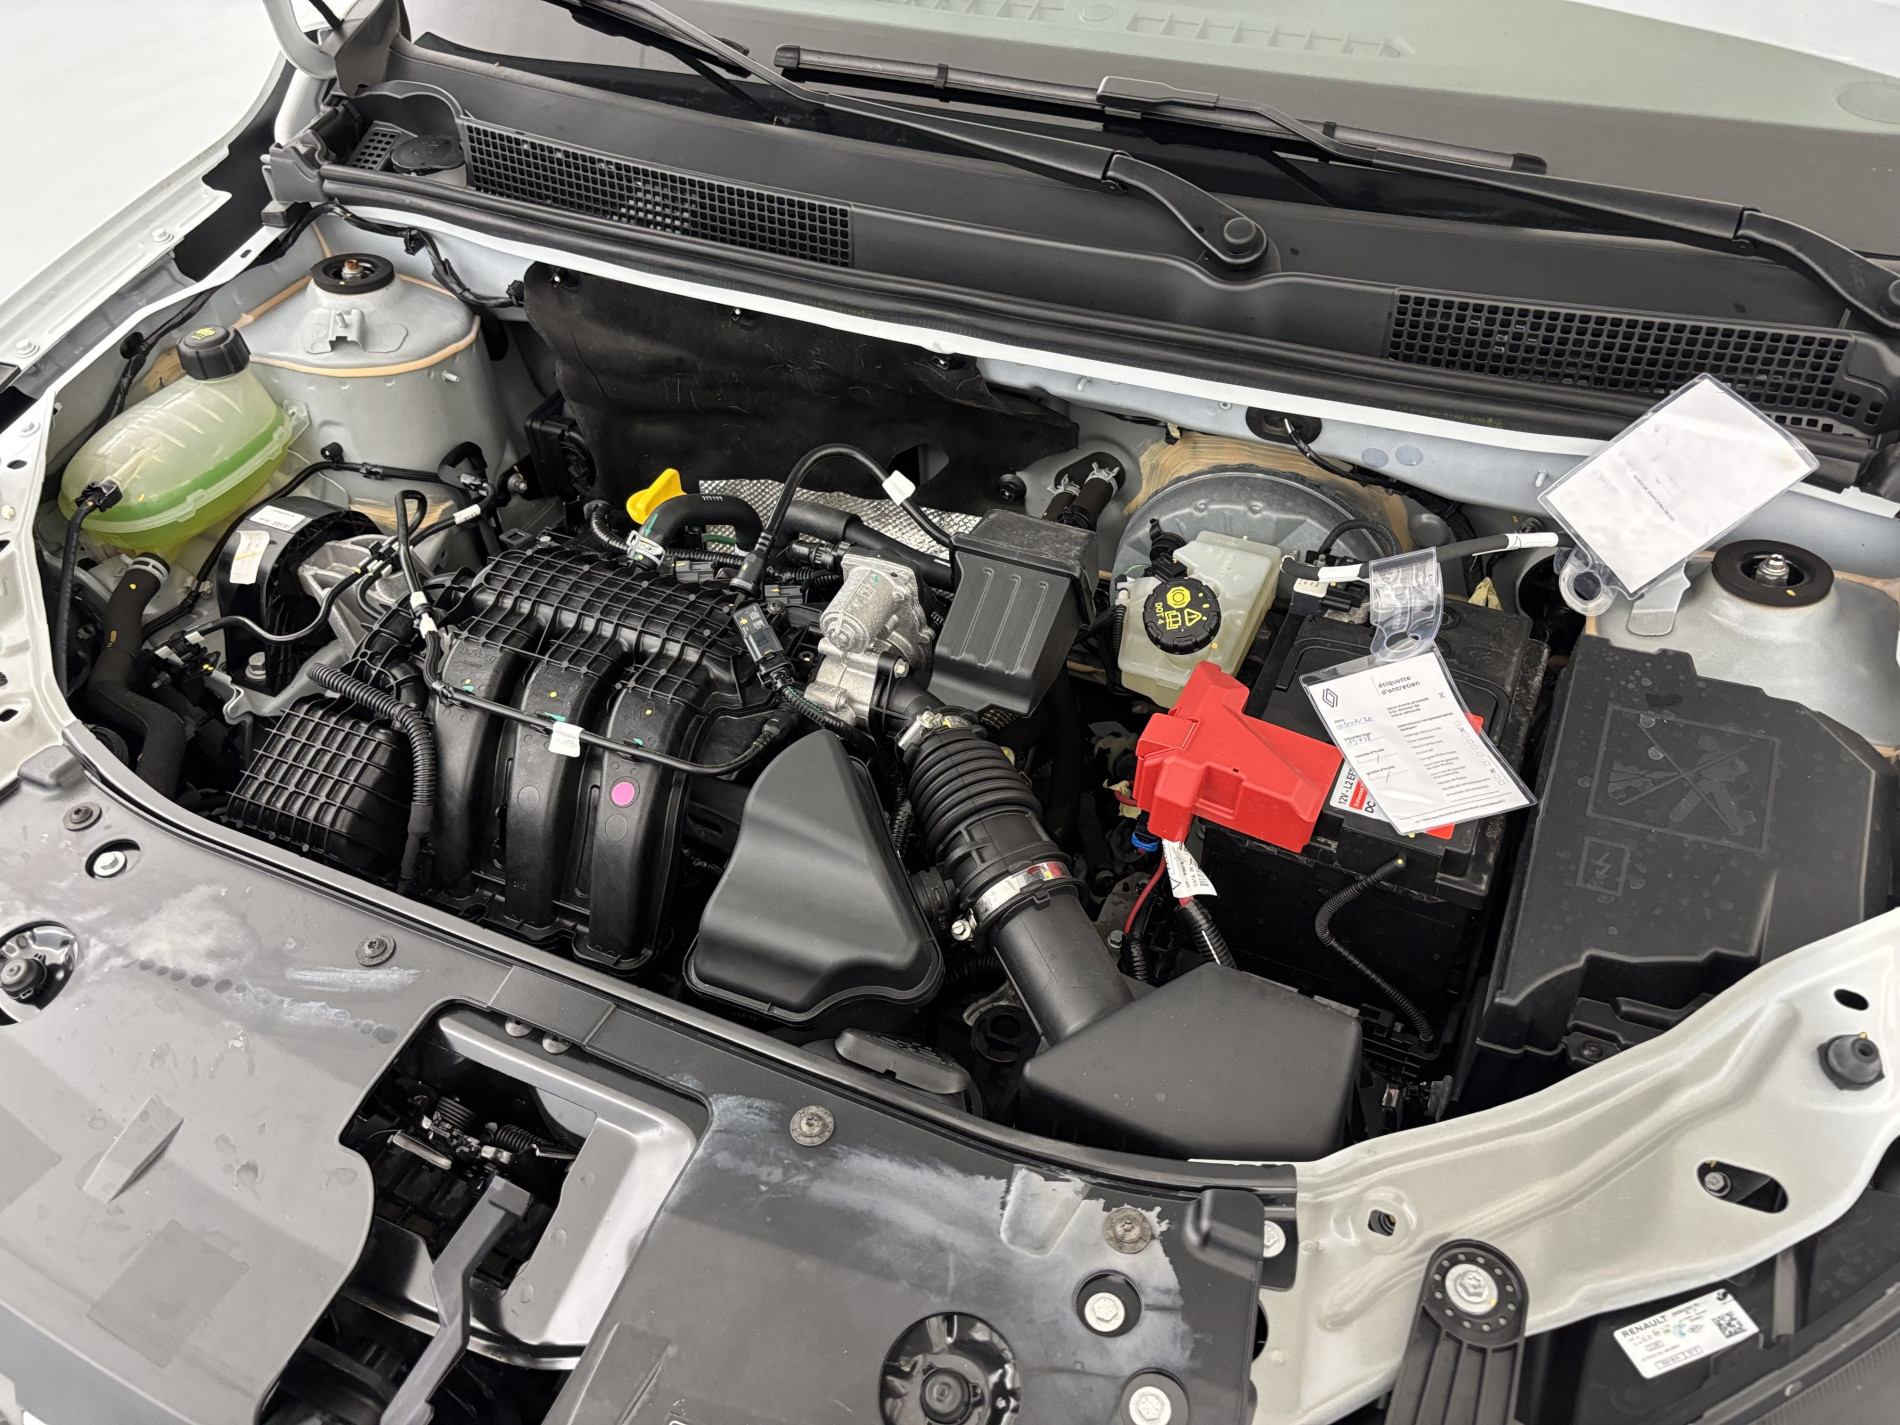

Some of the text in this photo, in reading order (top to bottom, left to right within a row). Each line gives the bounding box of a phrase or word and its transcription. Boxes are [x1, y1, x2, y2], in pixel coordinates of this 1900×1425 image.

[1155, 602, 1164, 617] DOT
[1378, 676, 1411, 689] étiquette
[1381, 681, 1421, 695] d'entretien
[1343, 780, 1354, 790] L2
[1338, 792, 1349, 804] 12V
[1364, 801, 1376, 814] DC
[1620, 1314, 1667, 1338] RENAULT
